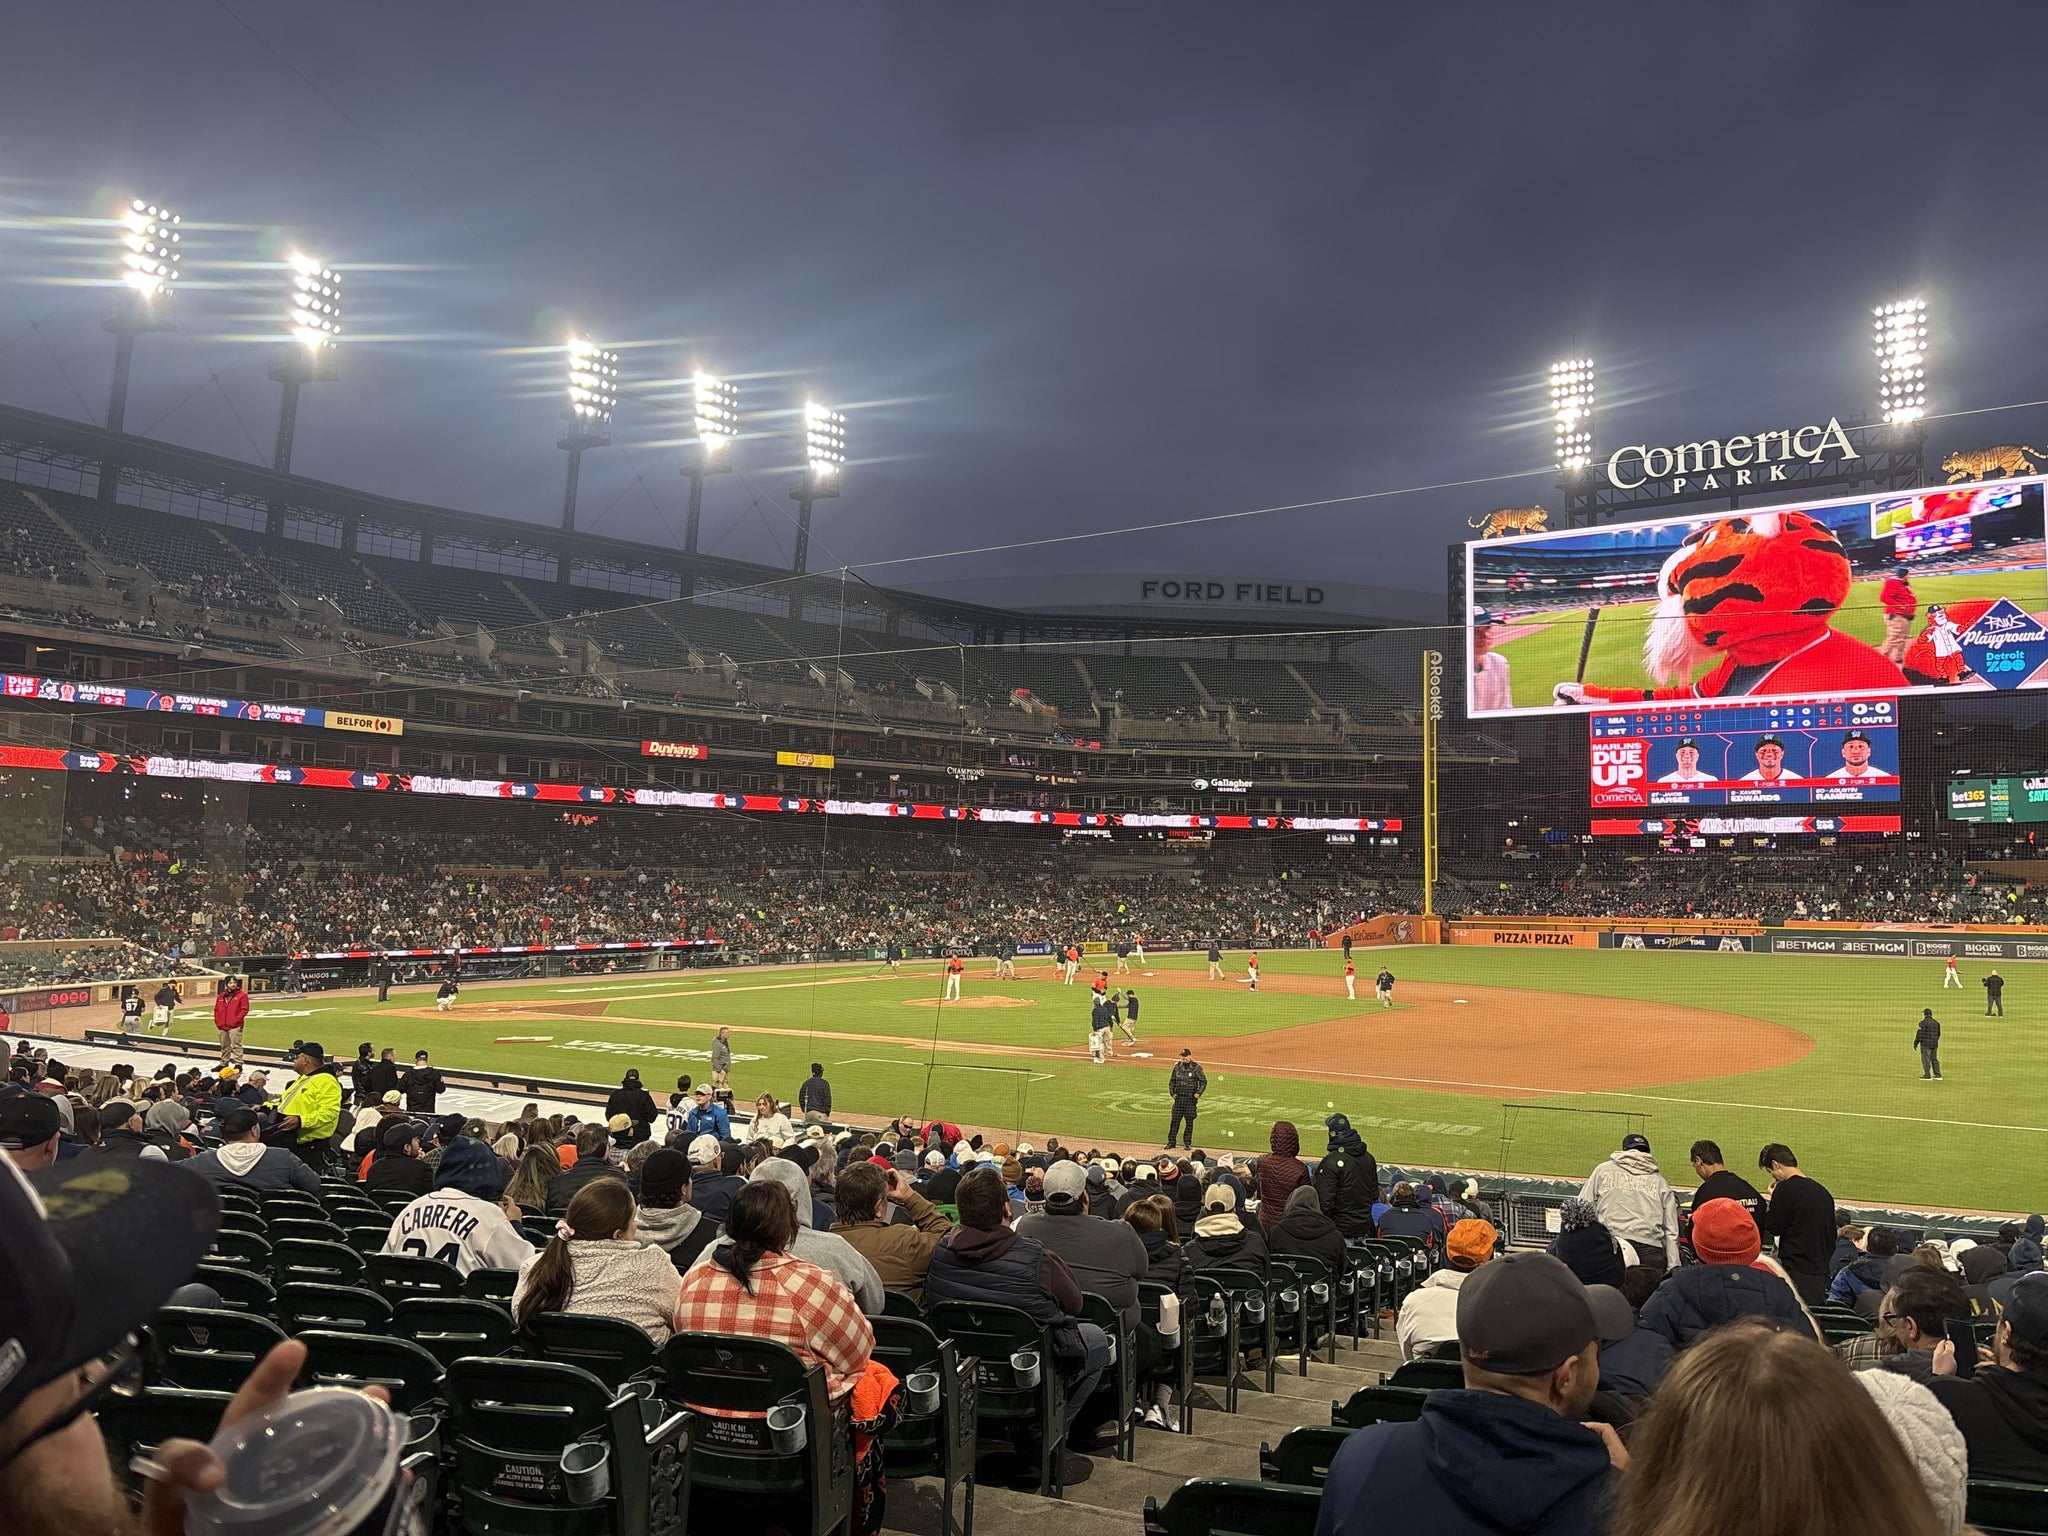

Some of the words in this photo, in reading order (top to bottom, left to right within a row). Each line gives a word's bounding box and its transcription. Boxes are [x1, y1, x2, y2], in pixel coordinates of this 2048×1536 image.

[1673, 465, 1787, 494] PARK
[1142, 580, 1225, 600] FORD
[1236, 583, 1324, 604] FIELD
[1963, 627, 2046, 649] Playground
[1986, 651, 2025, 661] Detroit
[1986, 659, 2026, 673] ZOO
[8, 676, 35, 686] DUE
[8, 685, 34, 695] UP
[78, 684, 126, 697] MARSEE
[1430, 666, 1444, 721] Rocket
[176, 695, 228, 708] EDWARDS
[1770, 709, 1778, 717] 0
[1786, 708, 1794, 716] 2
[1802, 707, 1810, 715] 0
[1852, 702, 1891, 715] 0-0
[336, 716, 373, 728] BELFOR
[1802, 719, 1811, 727] 0
[1818, 718, 1827, 726] 2
[1861, 715, 1892, 723] OUTS
[649, 741, 699, 755] Dunham's
[1592, 742, 1642, 751] MARLINS
[1592, 750, 1642, 765] DUE
[947, 766, 985, 777] CHAMPIONS
[1592, 764, 1643, 787] UP
[1211, 778, 1253, 789] Gallagher
[1731, 794, 1780, 802] EDWARDS
[1952, 790, 1985, 802] bet365
[1494, 931, 1533, 945] PIZZA!
[1535, 932, 1574, 946] PIZZA!
[1785, 941, 1836, 951] BETMGM
[1853, 942, 1905, 952] BETMGM
[126, 1002, 138, 1012] 87
[401, 1204, 480, 1241] CABRERA
[505, 1464, 544, 1476] CAUTION
